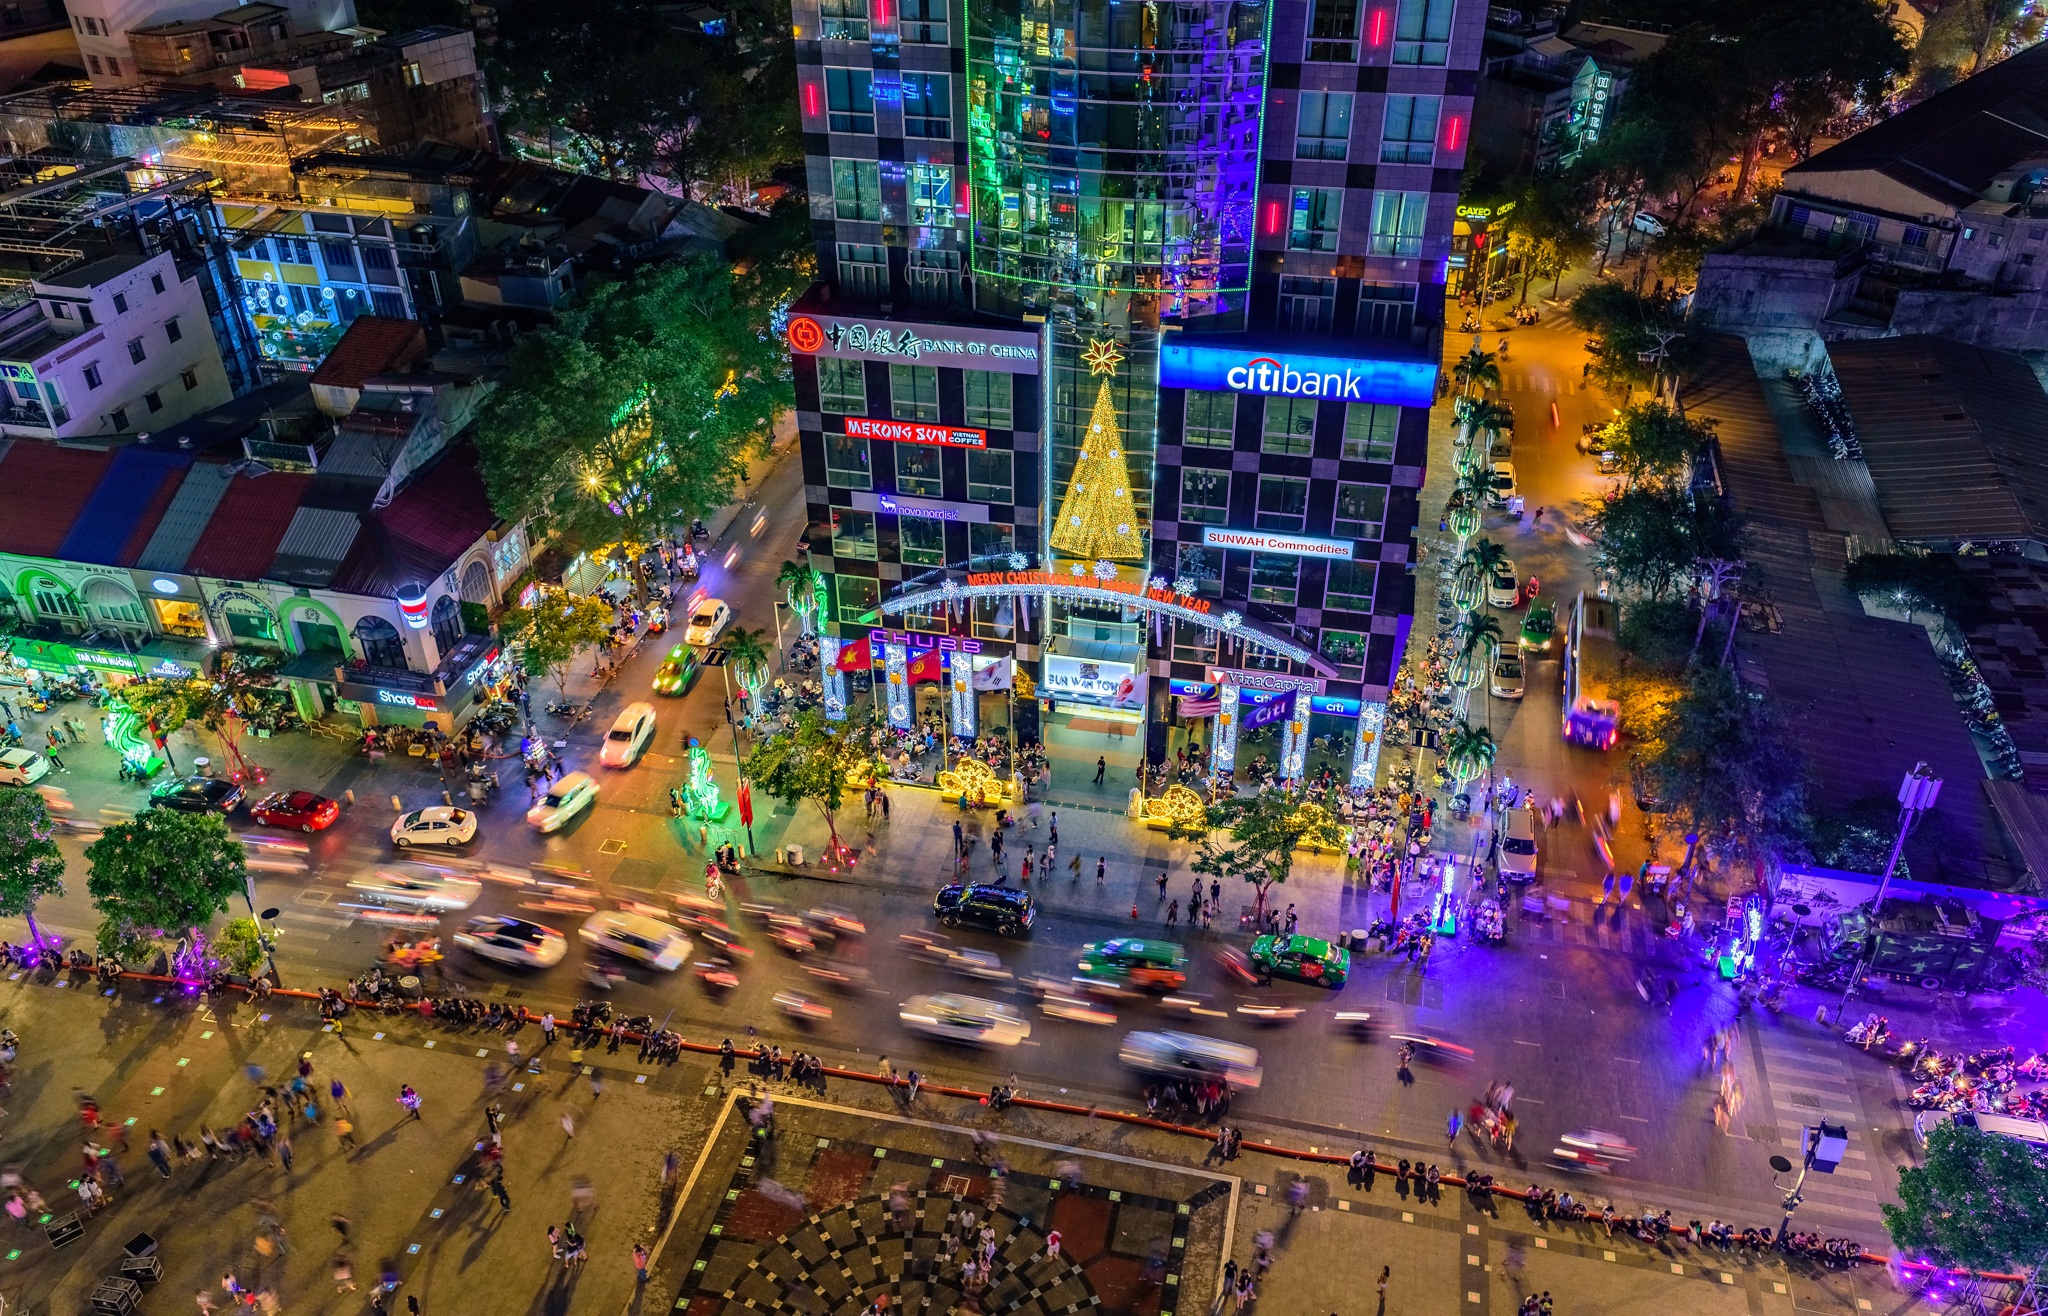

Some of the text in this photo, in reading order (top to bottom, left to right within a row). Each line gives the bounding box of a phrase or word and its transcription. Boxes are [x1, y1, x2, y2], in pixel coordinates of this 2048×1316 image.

[1587, 77, 1609, 140] HOTEL
[923, 338, 1037, 360] BANK OF CHINA
[1226, 361, 1361, 399] citibank
[847, 420, 947, 443] MEKONG SUN
[948, 436, 984, 446] COFFEE
[952, 431, 980, 439] VIETNAM
[898, 506, 957, 520] novo nordisk
[1208, 532, 1349, 556] SUNWAH Commodities
[966, 571, 1211, 614] MERRY CHRISTMAS AND HAPPY NEW YEAR
[870, 629, 940, 654] CHUBB
[1183, 683, 1202, 695] citi
[1226, 670, 1320, 694] VinaCapital
[1255, 700, 1287, 724] Citi
[1326, 701, 1345, 713] citi
